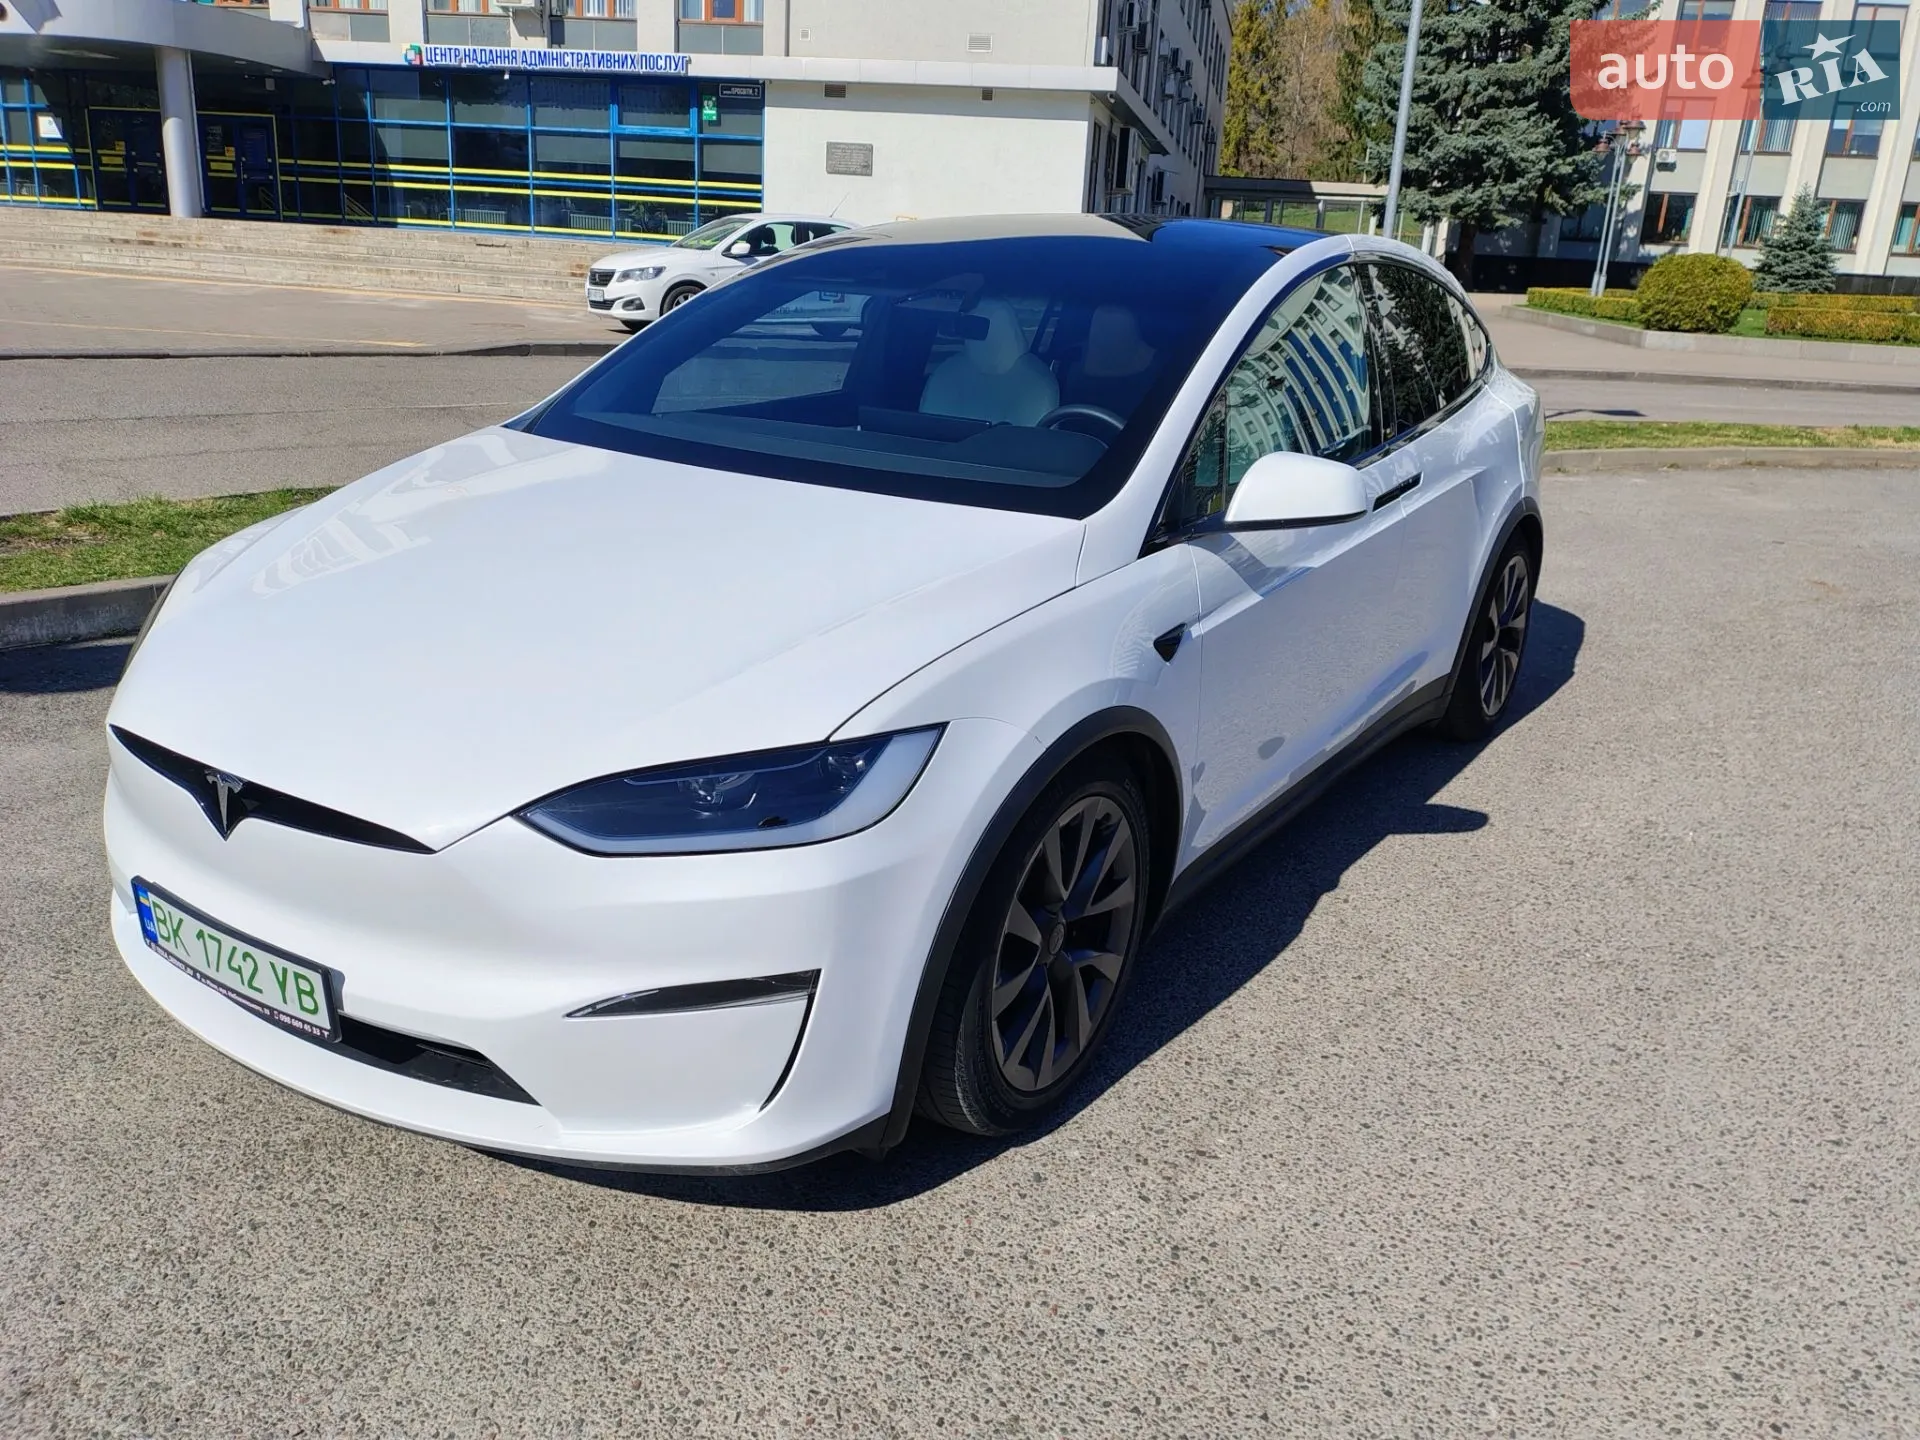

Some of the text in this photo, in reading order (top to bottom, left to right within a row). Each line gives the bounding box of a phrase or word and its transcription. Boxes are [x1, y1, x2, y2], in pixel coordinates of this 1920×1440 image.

[425, 46, 688, 72] ЦЕНТР НАДАННЯ АДМІНІСТРАТИВНИХ ПОСЛУГ
[151, 900, 191, 957] BK
[196, 928, 263, 994] 1742
[269, 961, 319, 1015] YB
